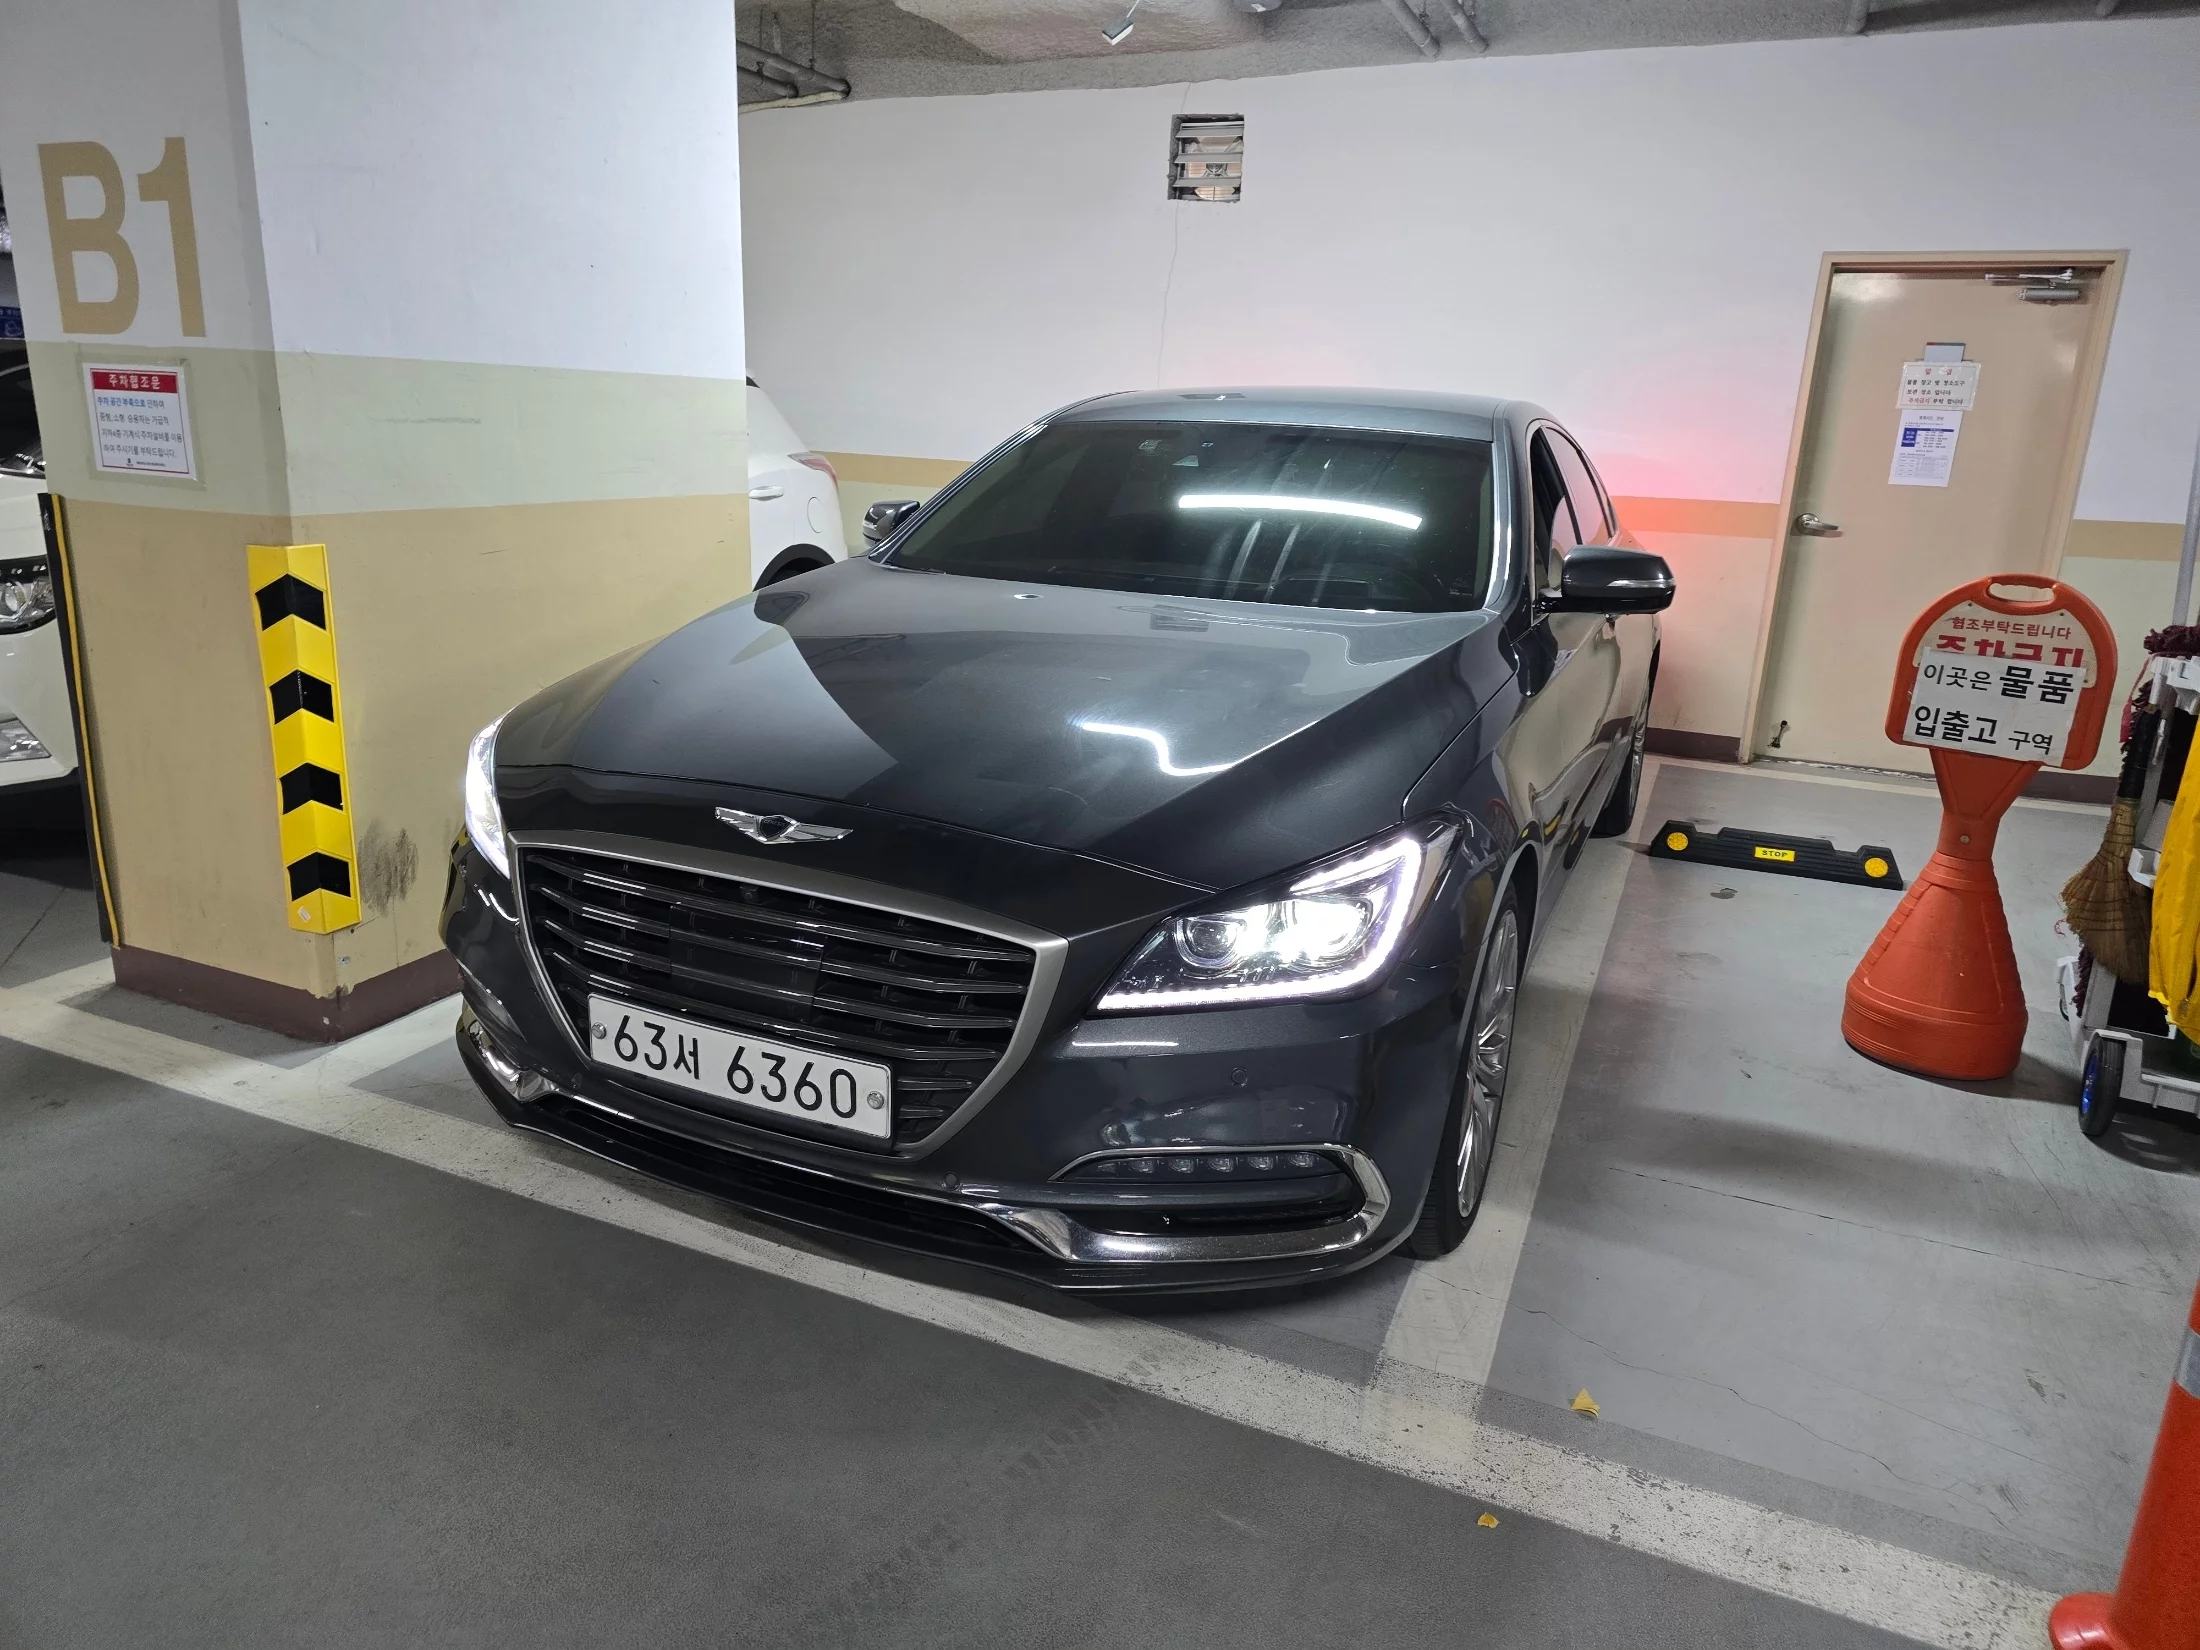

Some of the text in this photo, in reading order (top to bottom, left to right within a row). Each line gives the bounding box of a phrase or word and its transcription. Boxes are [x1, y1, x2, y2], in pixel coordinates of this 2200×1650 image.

[37, 136, 206, 338] B1
[108, 374, 161, 390] 주차협조문
[97, 396, 109, 406] 주차
[110, 397, 122, 407] 공간
[122, 398, 146, 408] 부족으로
[127, 414, 151, 425] 승용차는
[151, 415, 169, 426] 가급적
[116, 444, 139, 456] 주시기를
[1952, 616, 2072, 640] 협조부탁드립니다
[1924, 664, 2074, 705] 이곳은 물품
[1914, 705, 2053, 756] 입출고 구역
[1762, 850, 1788, 858] STOP
[614, 1014, 857, 1119] 63서 6360
